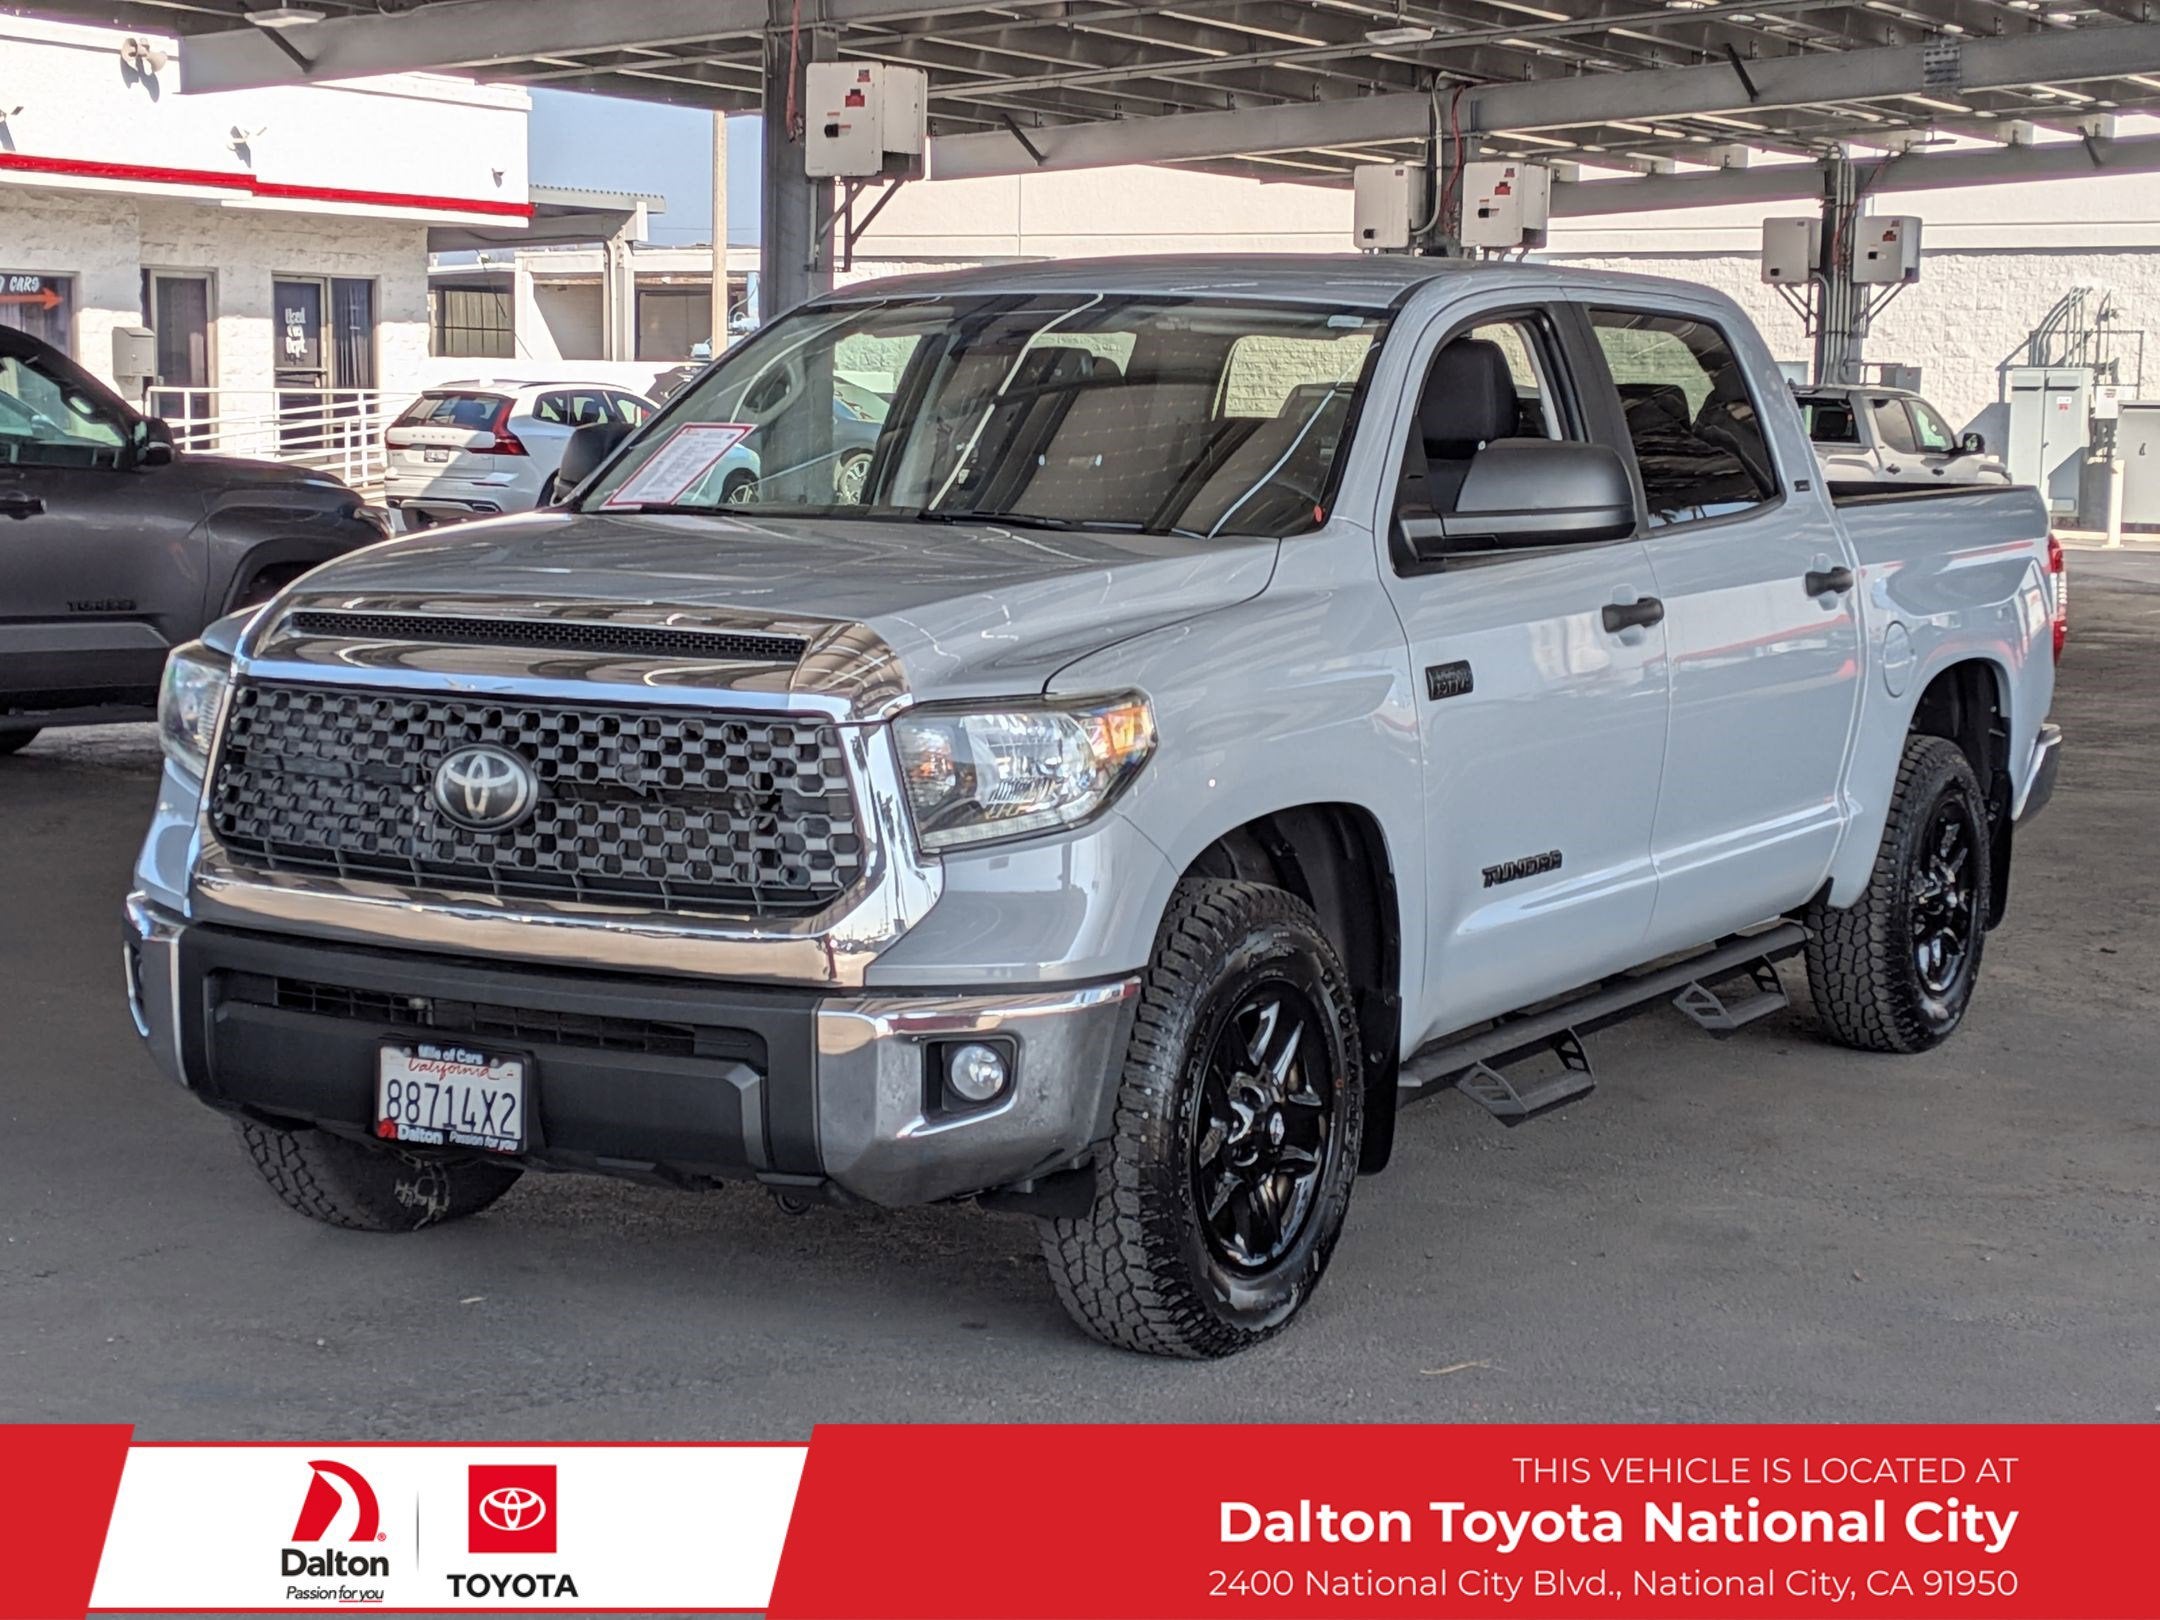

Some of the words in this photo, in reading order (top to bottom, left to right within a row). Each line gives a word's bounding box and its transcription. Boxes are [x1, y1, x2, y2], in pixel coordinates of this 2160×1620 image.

[9, 276, 40, 293] CARS
[285, 307, 306, 325] Used
[1482, 849, 1562, 888] TUNDRA
[418, 1044, 441, 1060] Mile
[443, 1047, 456, 1062] of
[456, 1048, 483, 1065] Cars
[408, 1057, 500, 1081] California
[387, 1079, 516, 1137] 88714X2
[398, 1125, 443, 1145] Dalton
[449, 1130, 484, 1146] Passion
[485, 1135, 499, 1148] for
[498, 1139, 518, 1151] you
